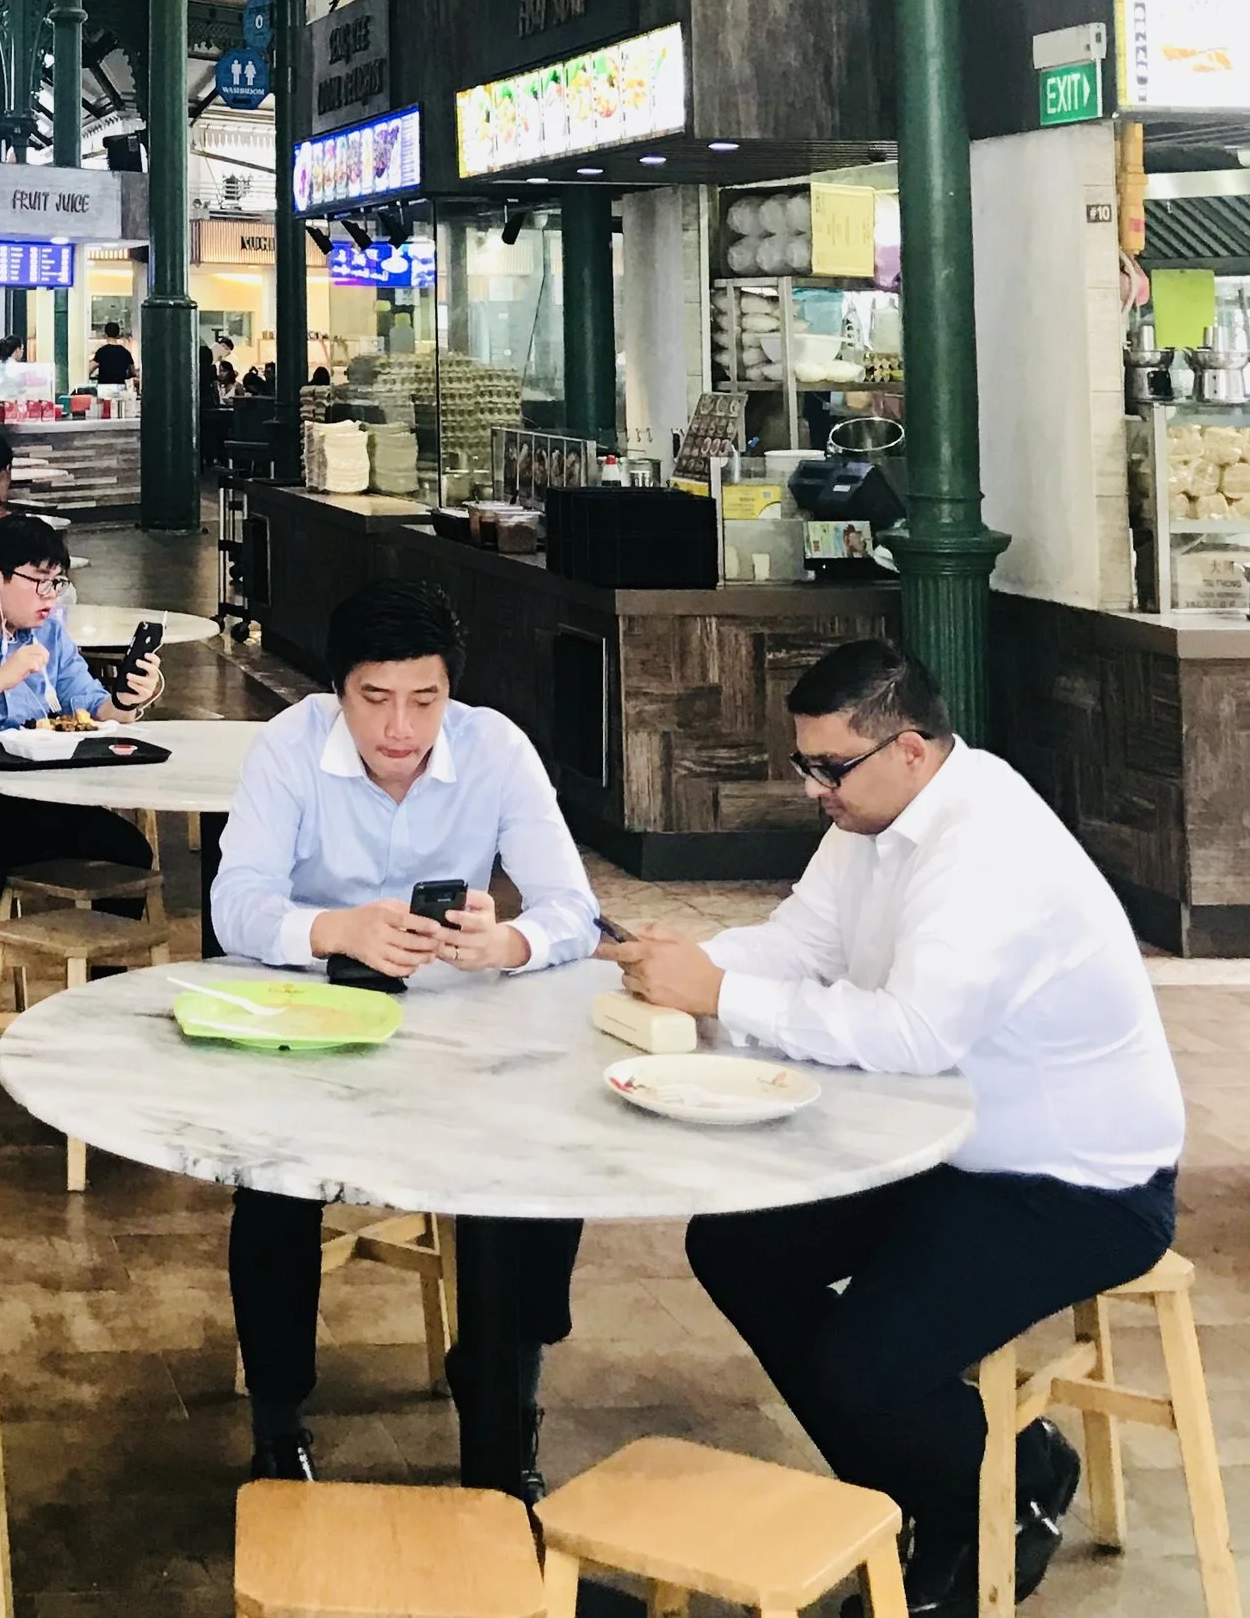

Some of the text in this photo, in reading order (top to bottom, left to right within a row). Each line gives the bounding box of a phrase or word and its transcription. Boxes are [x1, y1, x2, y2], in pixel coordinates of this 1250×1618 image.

[222, 85, 266, 96] WASHROOM
[1046, 73, 1081, 115] EXIT
[12, 189, 90, 214] FRUIT JUICE
[1089, 204, 1112, 221] #10
